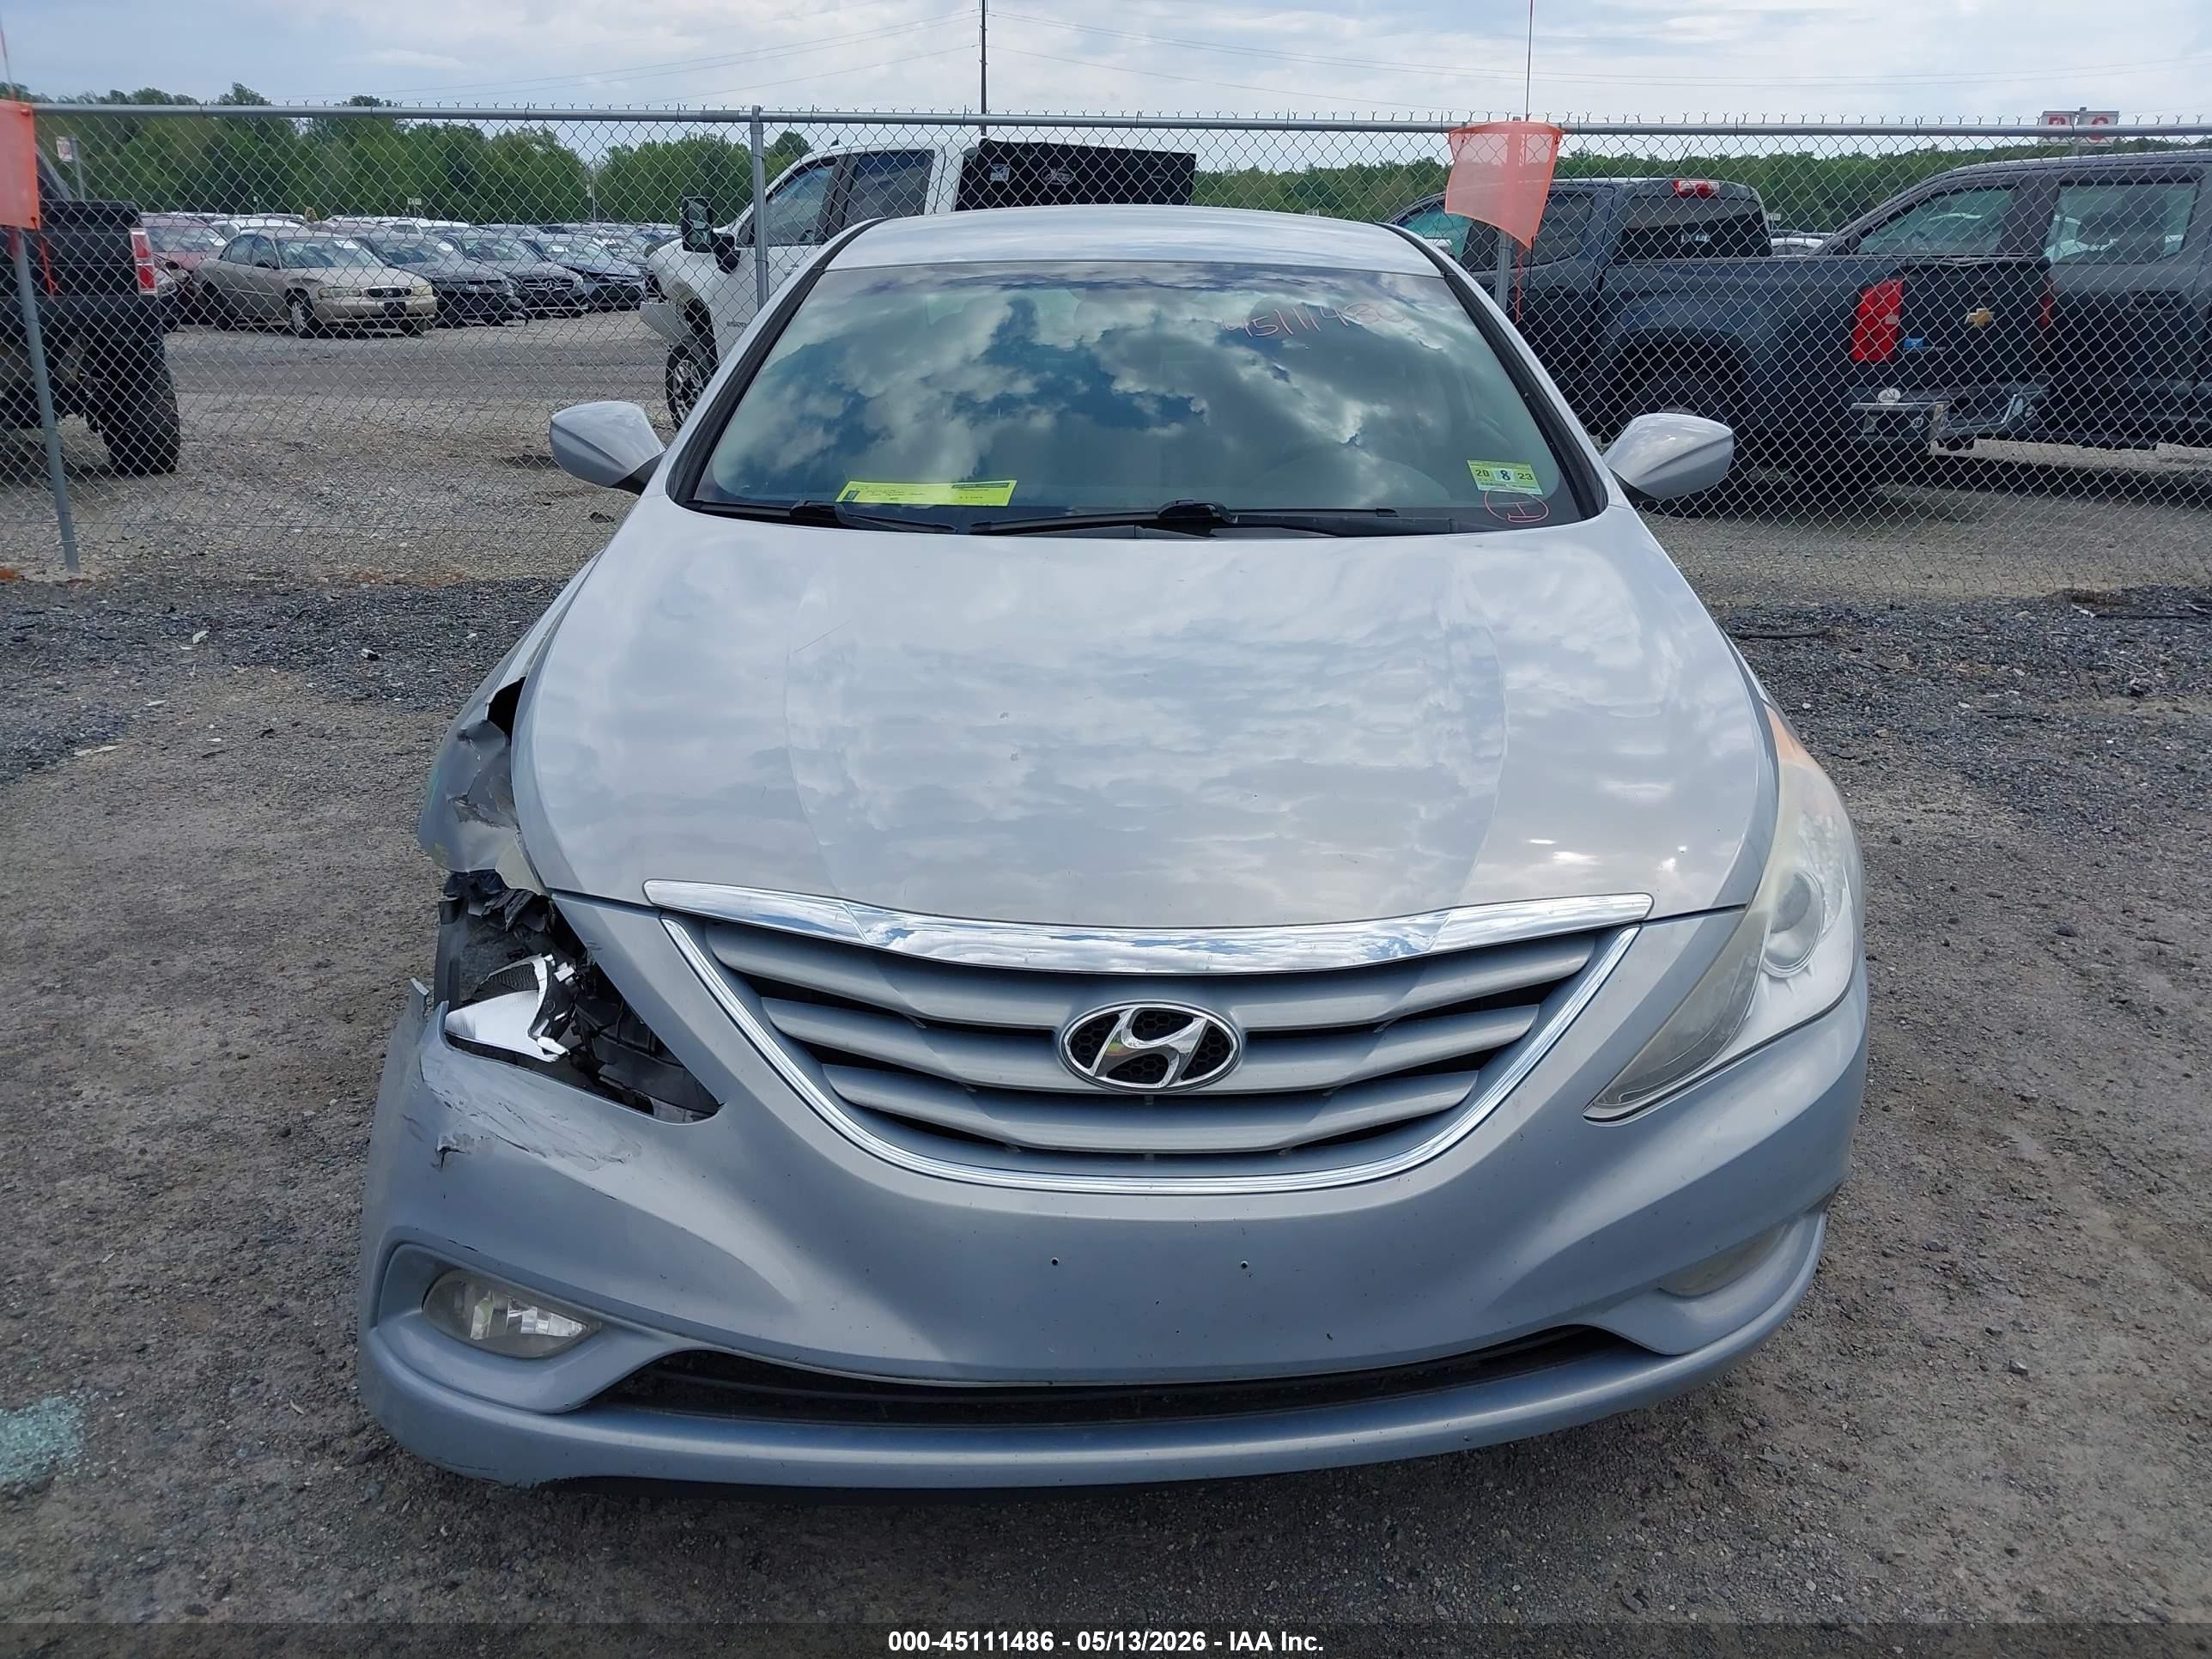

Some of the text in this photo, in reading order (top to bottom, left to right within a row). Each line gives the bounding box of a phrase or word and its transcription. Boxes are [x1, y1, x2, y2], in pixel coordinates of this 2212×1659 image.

[1475, 469, 1533, 481] 20 8 23
